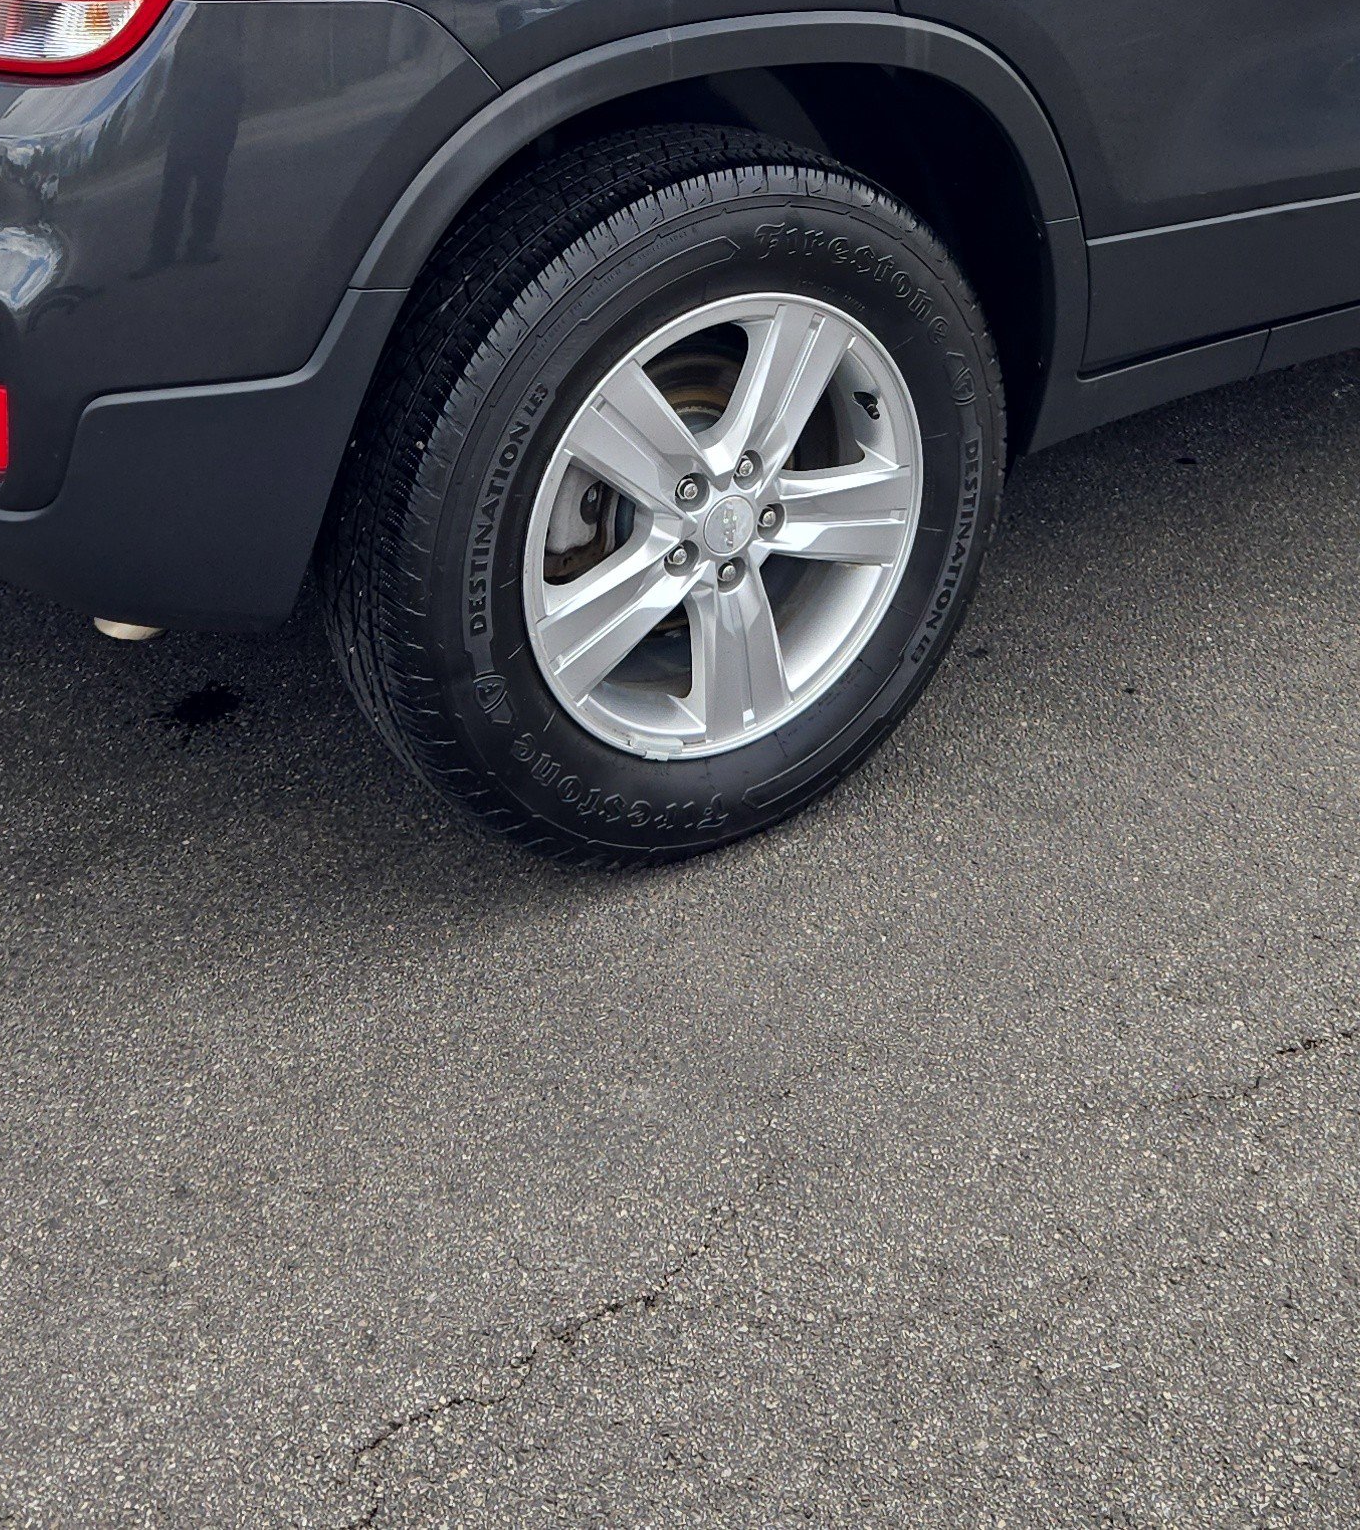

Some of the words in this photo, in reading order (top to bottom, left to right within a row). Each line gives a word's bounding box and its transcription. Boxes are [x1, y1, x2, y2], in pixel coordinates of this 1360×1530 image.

[754, 222, 949, 345] Firestone
[468, 420, 531, 638] DESTINATION
[926, 437, 980, 630] DESTINATION
[510, 731, 730, 831] Firestone
